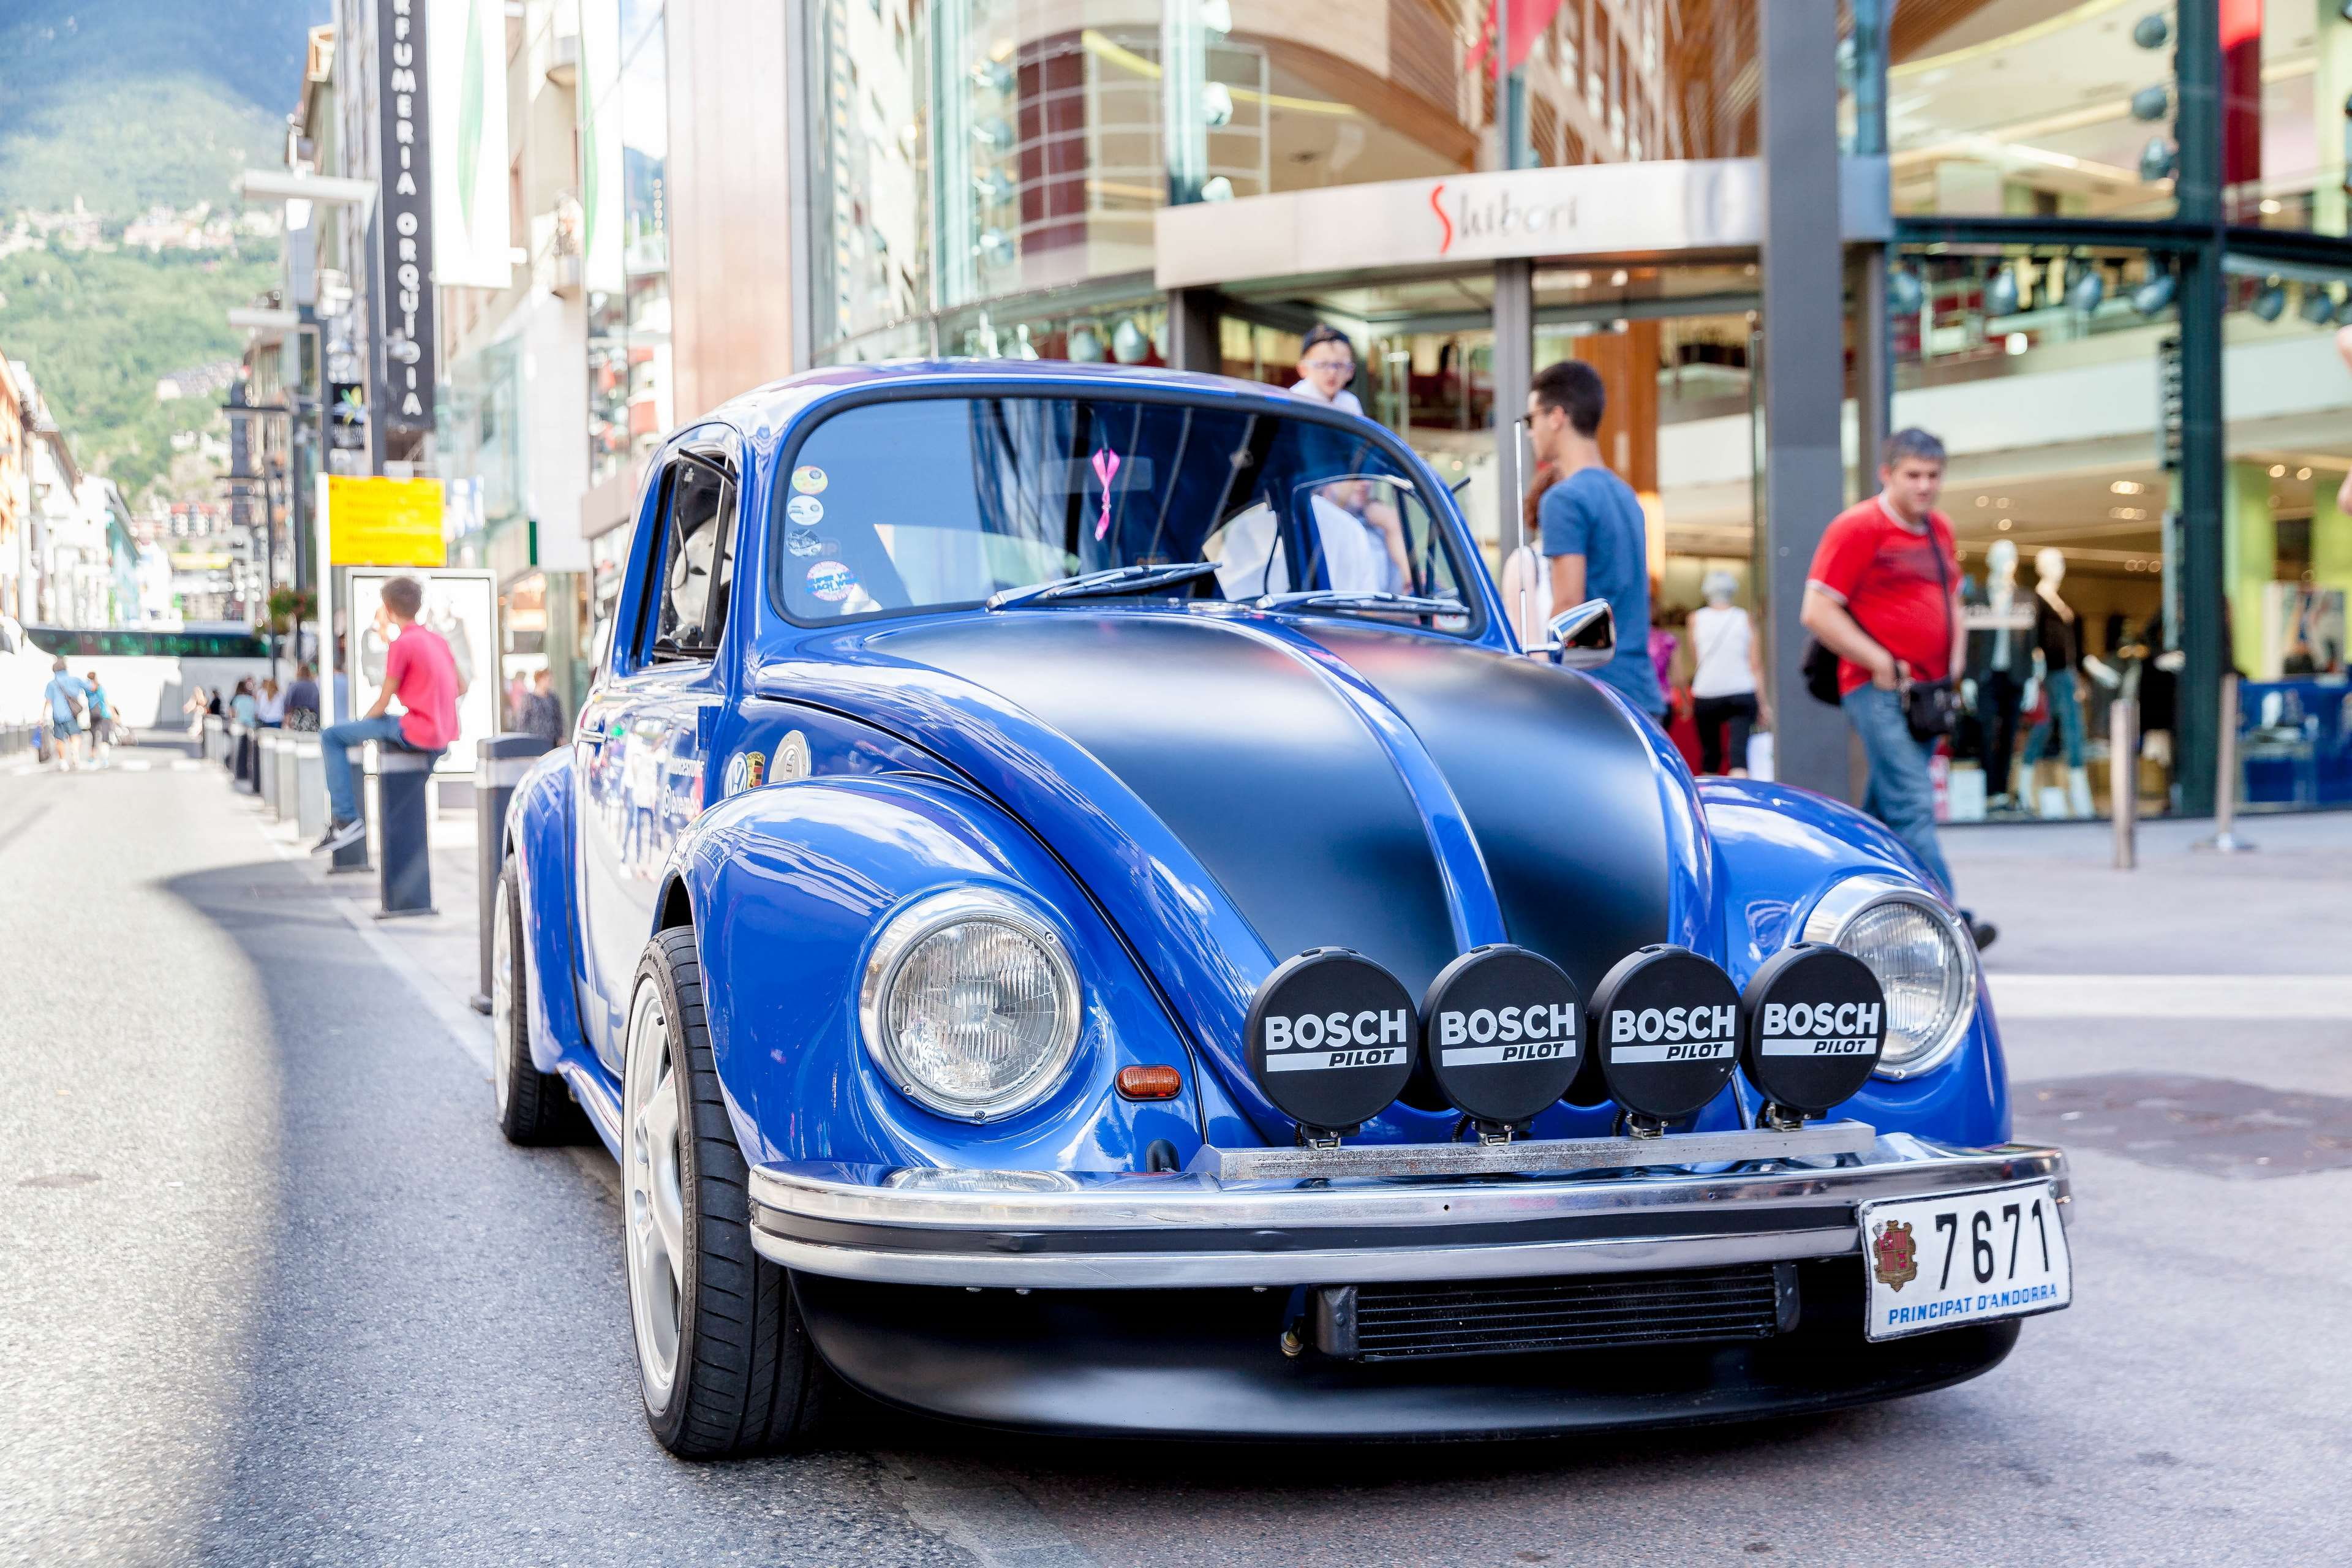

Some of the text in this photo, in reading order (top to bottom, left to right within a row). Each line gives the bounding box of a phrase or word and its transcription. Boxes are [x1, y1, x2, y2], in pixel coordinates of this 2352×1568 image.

[1265, 1008, 1408, 1050] BOSCH
[1440, 1003, 1575, 1046] BOSCH
[1611, 1005, 1736, 1044] BOSCH
[1762, 1002, 1880, 1036] BOSCH
[1329, 1049, 1395, 1067] PILOT
[1501, 1042, 1566, 1061] PILOT
[1666, 1042, 1724, 1060] PILOT
[1813, 1039, 1866, 1054] PILOT
[1935, 1199, 2049, 1291] 7671
[1887, 1283, 2059, 1325] PRINCIPAT D'ANDORRA
